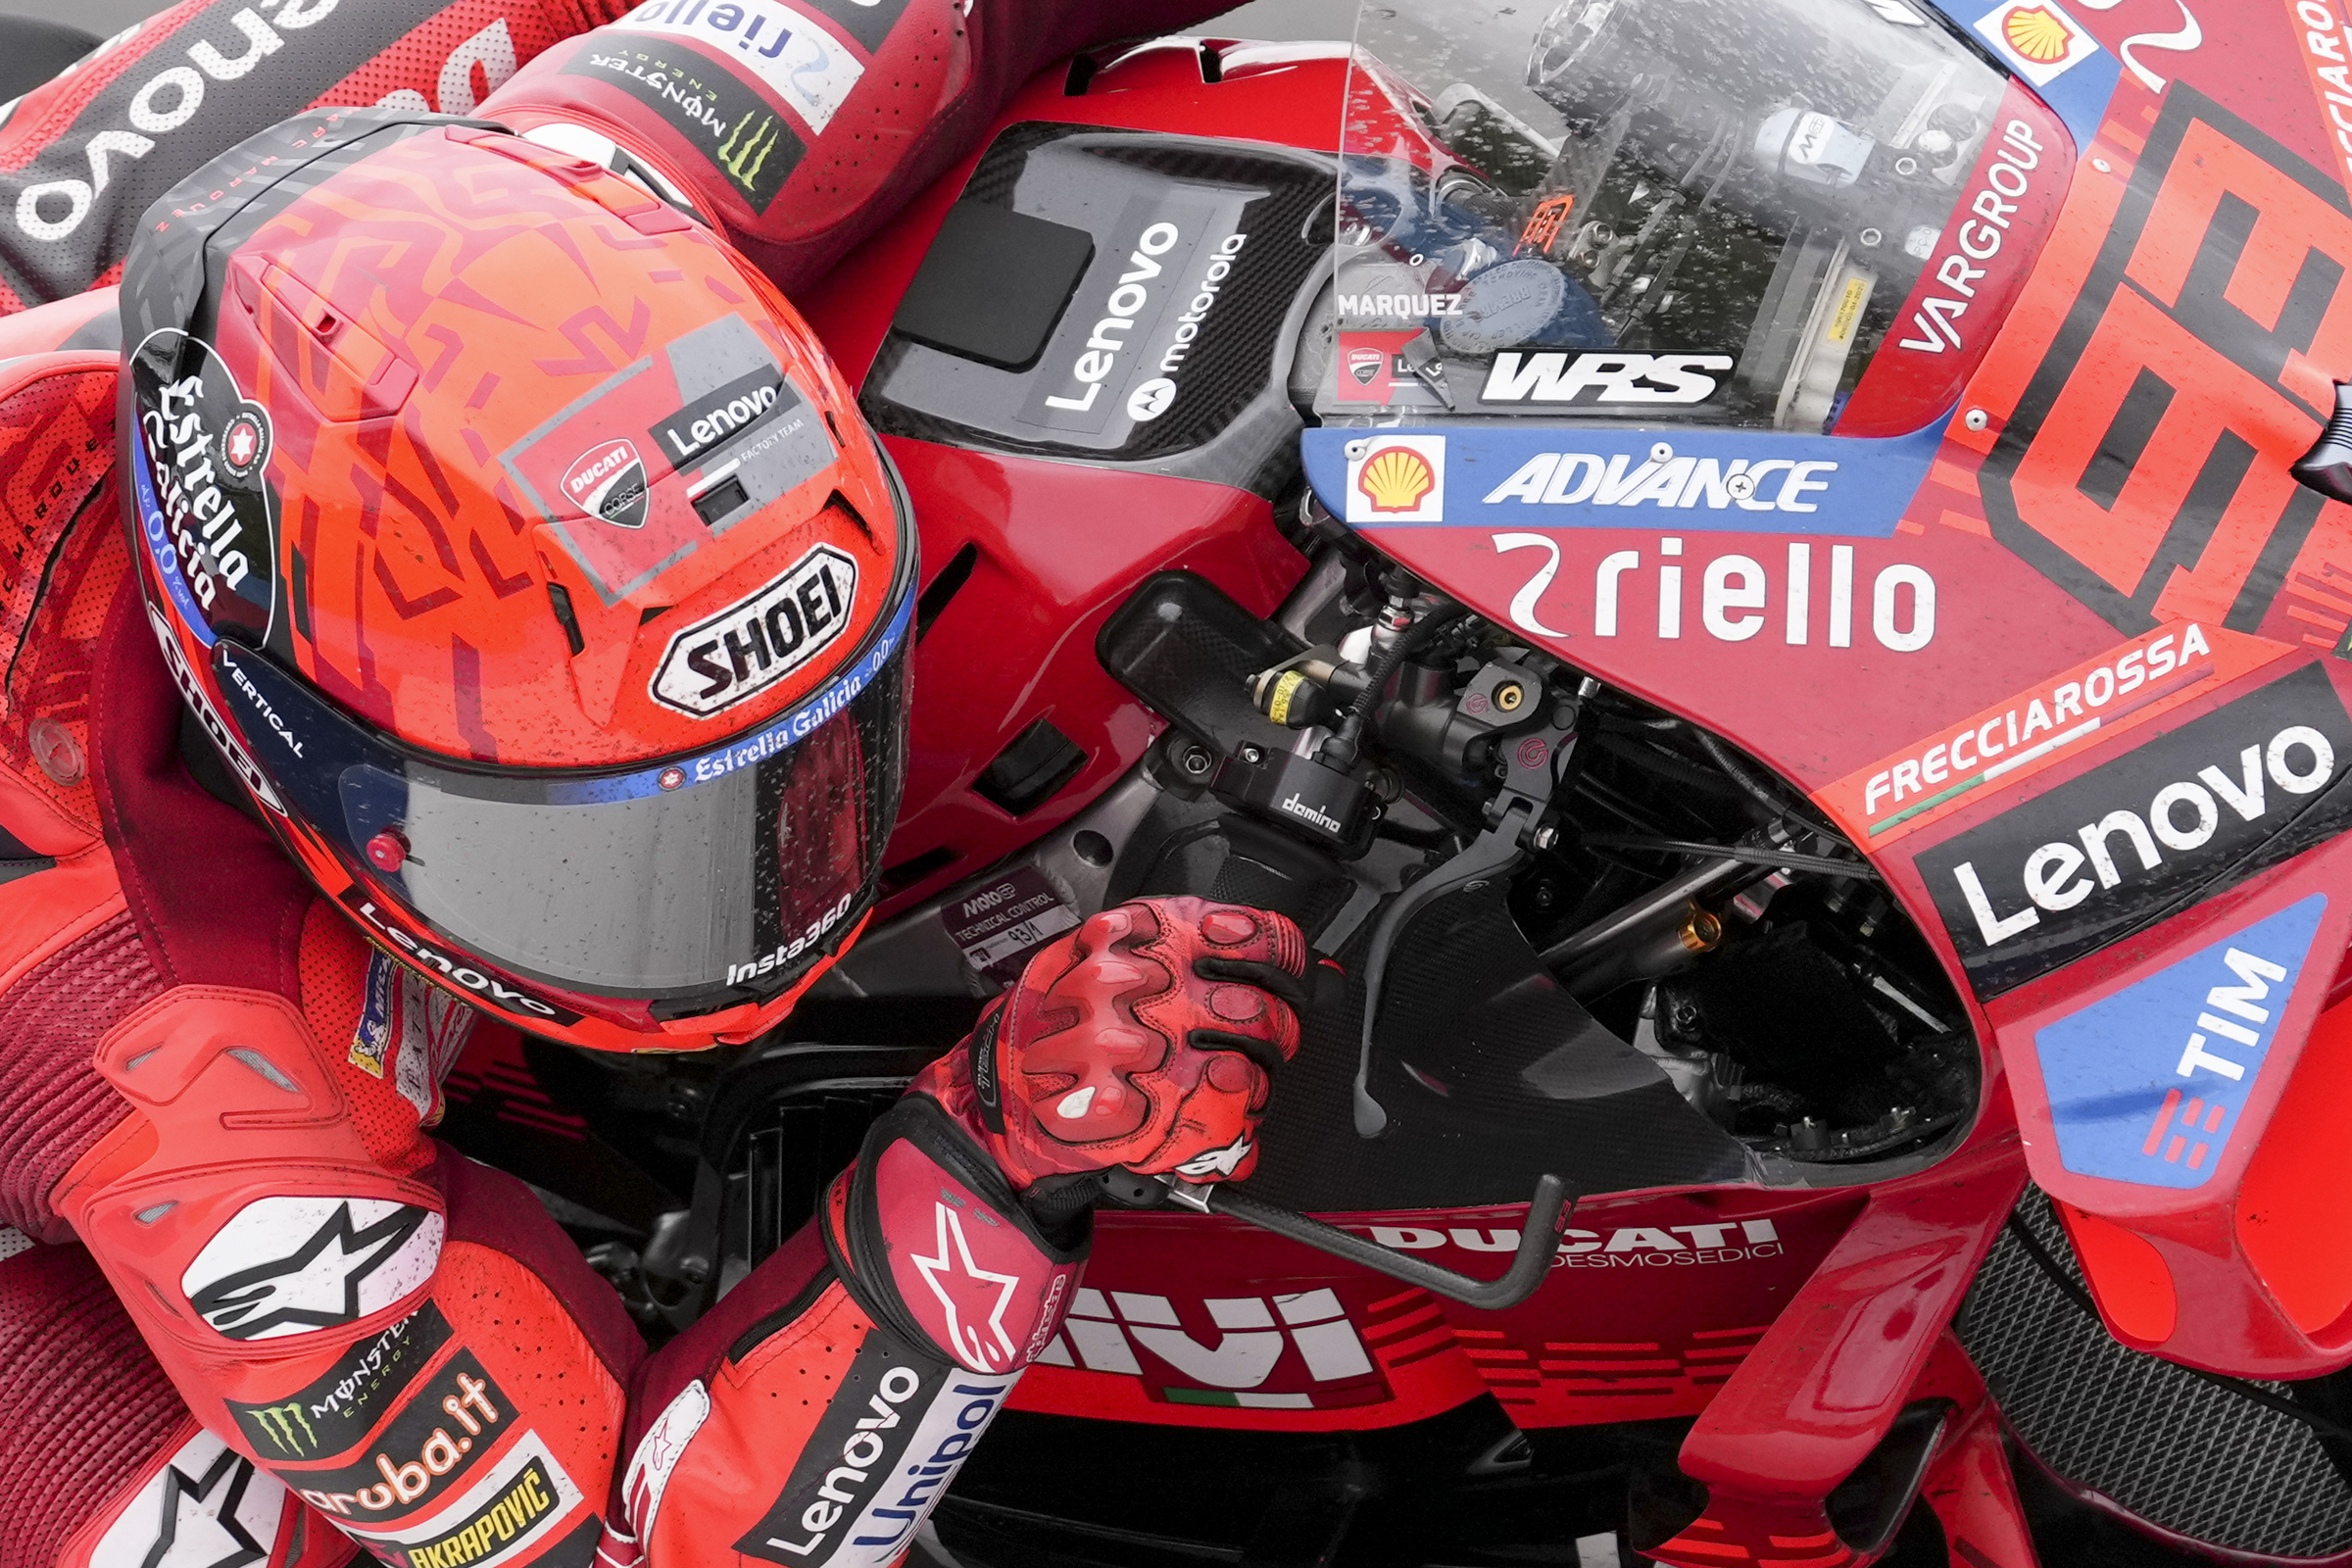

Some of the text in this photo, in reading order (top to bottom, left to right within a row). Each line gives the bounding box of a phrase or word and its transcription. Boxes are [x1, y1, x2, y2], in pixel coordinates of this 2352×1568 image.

[617, 49, 718, 101] ENERGY
[155, 155, 280, 233] MARQUEZ
[1899, 119, 2043, 354] VARGROUP
[1045, 221, 1179, 412] Lenovo
[1160, 233, 1248, 370] motorola
[1338, 294, 1463, 319] MARQUEZ
[666, 385, 777, 456] Lenovo
[1482, 352, 1734, 403] WRS
[158, 375, 249, 591] Estrella
[570, 446, 628, 494] DUCATI
[741, 418, 805, 462] FACTORY TEAM
[1482, 453, 1838, 513] ADVANCE
[604, 483, 640, 514] CORSE
[687, 564, 842, 700] SHOEI
[1595, 537, 1936, 652] riello
[222, 649, 303, 759] VERTICAL
[695, 728, 789, 782] Estrella
[793, 676, 862, 737] Galicia
[1864, 623, 2211, 815] FRECCIAROSSA
[1282, 794, 1341, 833] domino
[1953, 725, 2335, 947] Lenovo
[726, 892, 852, 986] Insta360
[956, 892, 1055, 943] TECHNICAL CONTROL
[962, 882, 1016, 920] MotoGP
[360, 902, 557, 1016] Lenovo
[2177, 947, 2287, 1081] TIM
[1369, 1218, 1779, 1252] DUCATI
[1550, 1243, 1785, 1269] DESMOSEDICI
[343, 1336, 412, 1418] ENERGY
[300, 1373, 499, 1514] aruba.it
[766, 1366, 919, 1556] Lenovo
[854, 1383, 1006, 1545] Unipol
